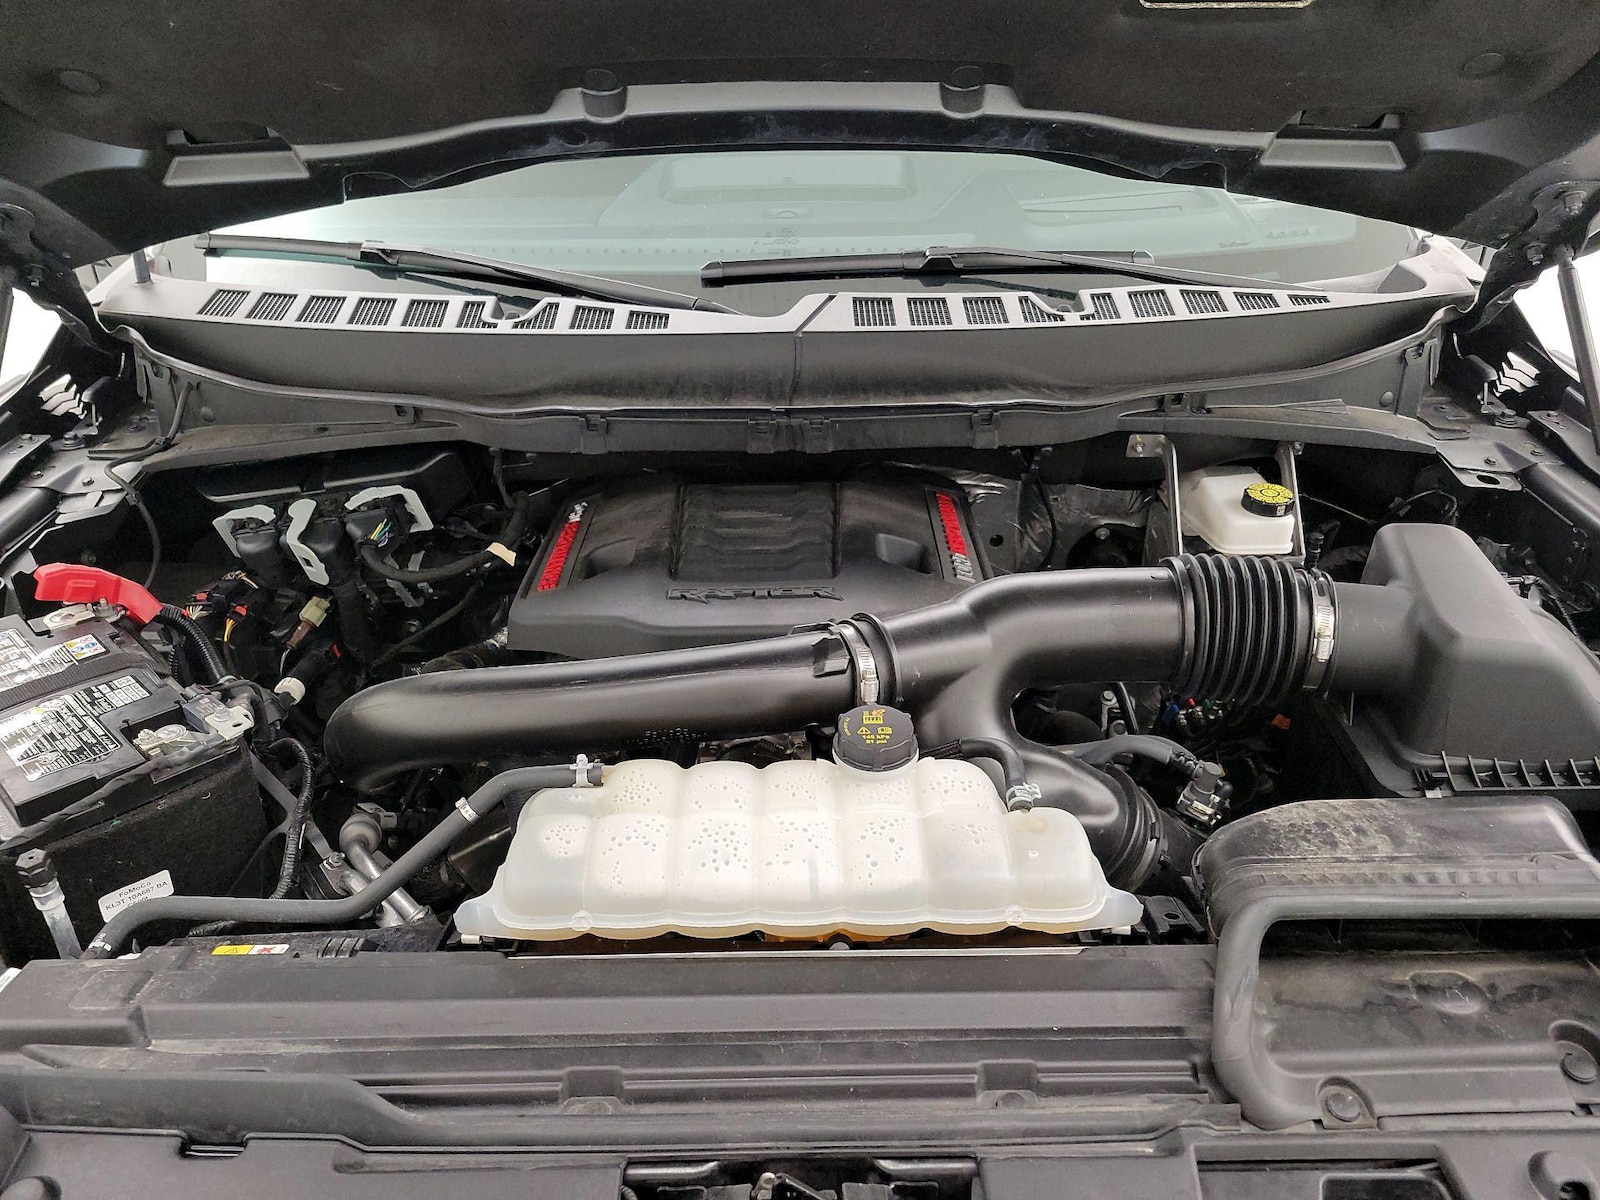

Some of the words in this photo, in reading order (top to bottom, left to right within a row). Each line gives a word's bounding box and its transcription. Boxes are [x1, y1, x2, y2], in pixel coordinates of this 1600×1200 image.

[665, 586, 845, 605] RAPTOR
[105, 899, 125, 911] KL3T
[156, 881, 168, 889] BA
[118, 882, 151, 897] FoMoCo
